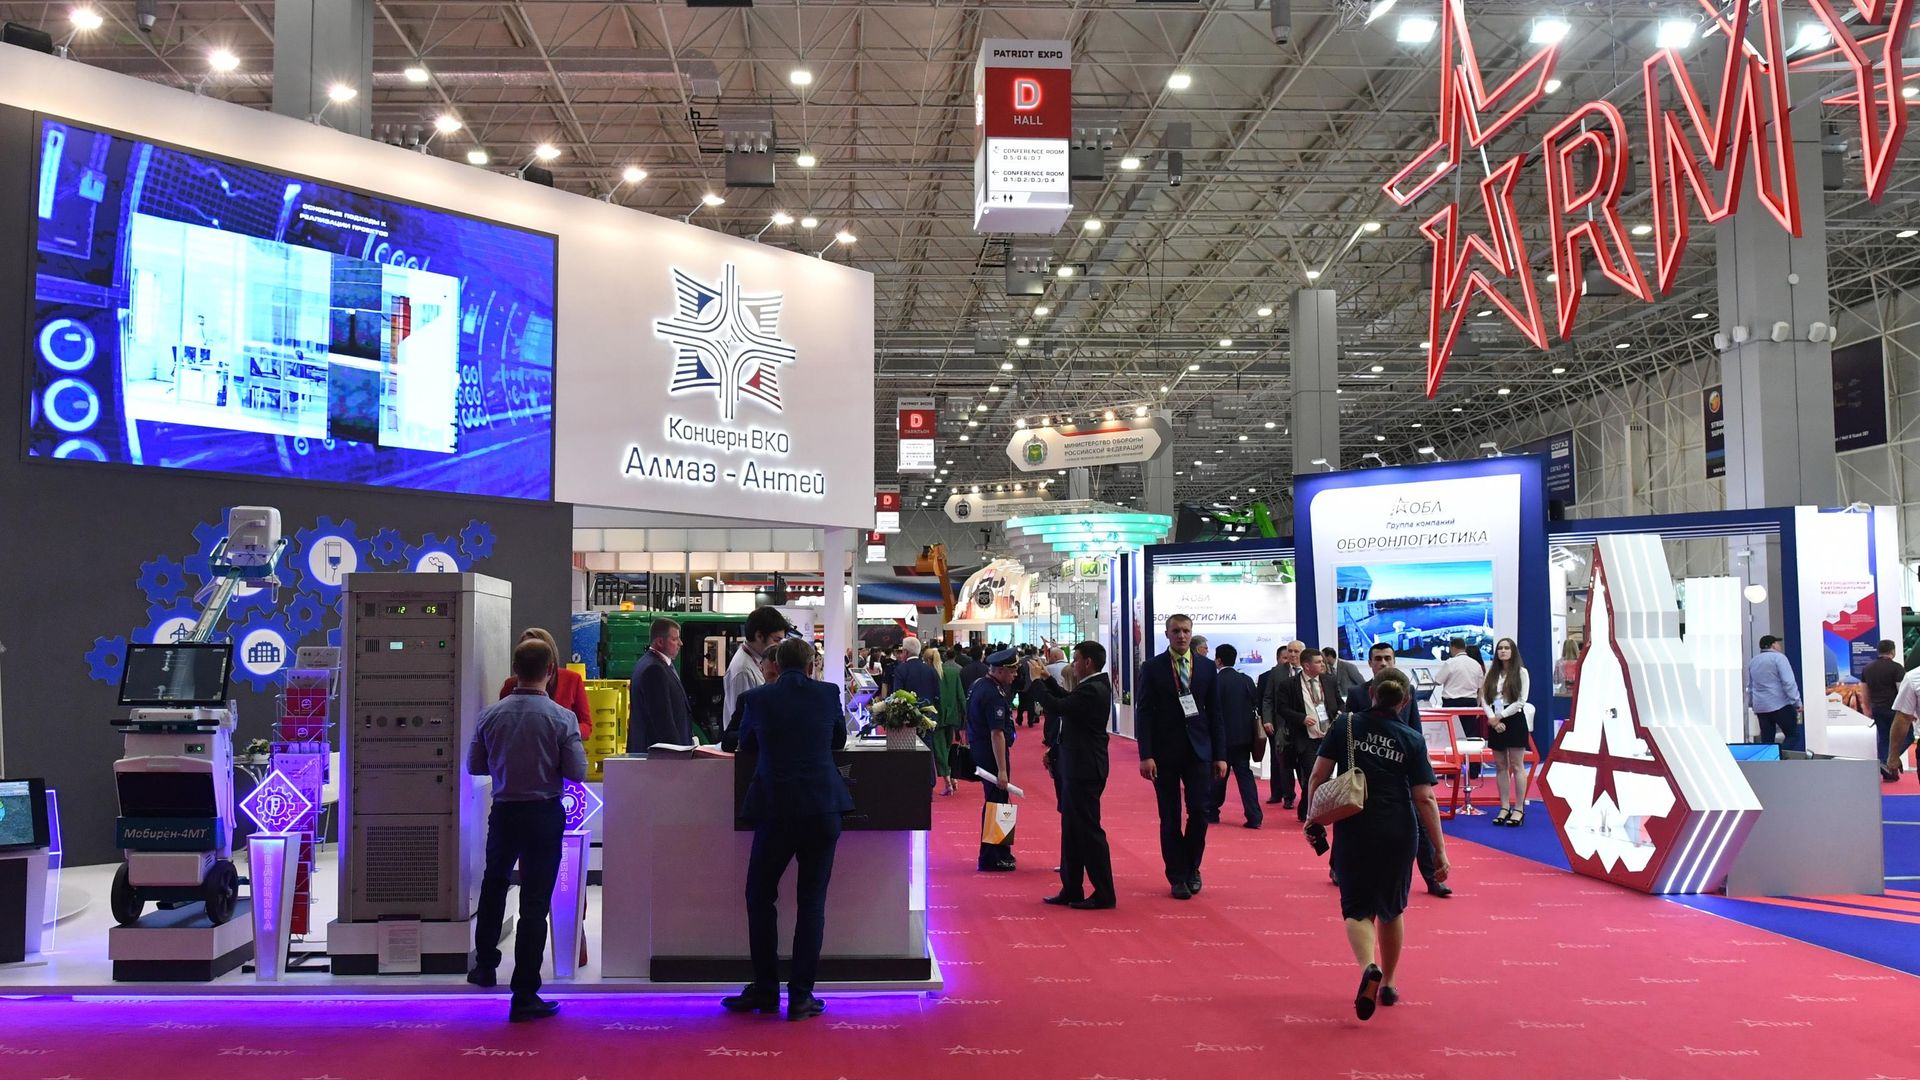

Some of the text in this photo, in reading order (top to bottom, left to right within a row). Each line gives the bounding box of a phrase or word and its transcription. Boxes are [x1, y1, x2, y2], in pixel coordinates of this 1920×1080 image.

[993, 50, 1063, 59] PATRIOT EXPO
[1015, 79, 1041, 109] D
[1013, 115, 1043, 125] HALL
[1383, 0, 1907, 399] ARMY
[299, 213, 351, 229] РЕАЛИЗАЦИИ
[302, 203, 343, 218] ОСНОВНЫЕ
[344, 213, 380, 226] ПОДХОДЫ
[911, 413, 923, 428] D
[669, 417, 789, 453] Концерн ВКО
[1064, 436, 1144, 448] МИНИСТЕРСТВО ОБОРОНЫ
[1064, 444, 1144, 456] РОССИЙСКОЙ ФЕДЕРАЦИИ
[625, 447, 716, 482] Алмаз
[743, 461, 825, 495] Антей
[1386, 518, 1456, 530] Группа компаний
[1336, 530, 1488, 550] ОБОРОНЛОГИСТИКА
[1366, 732, 1396, 749] МЧС
[1353, 739, 1404, 763] РОССИИ
[124, 828, 208, 840] Мобирен-4МТ
